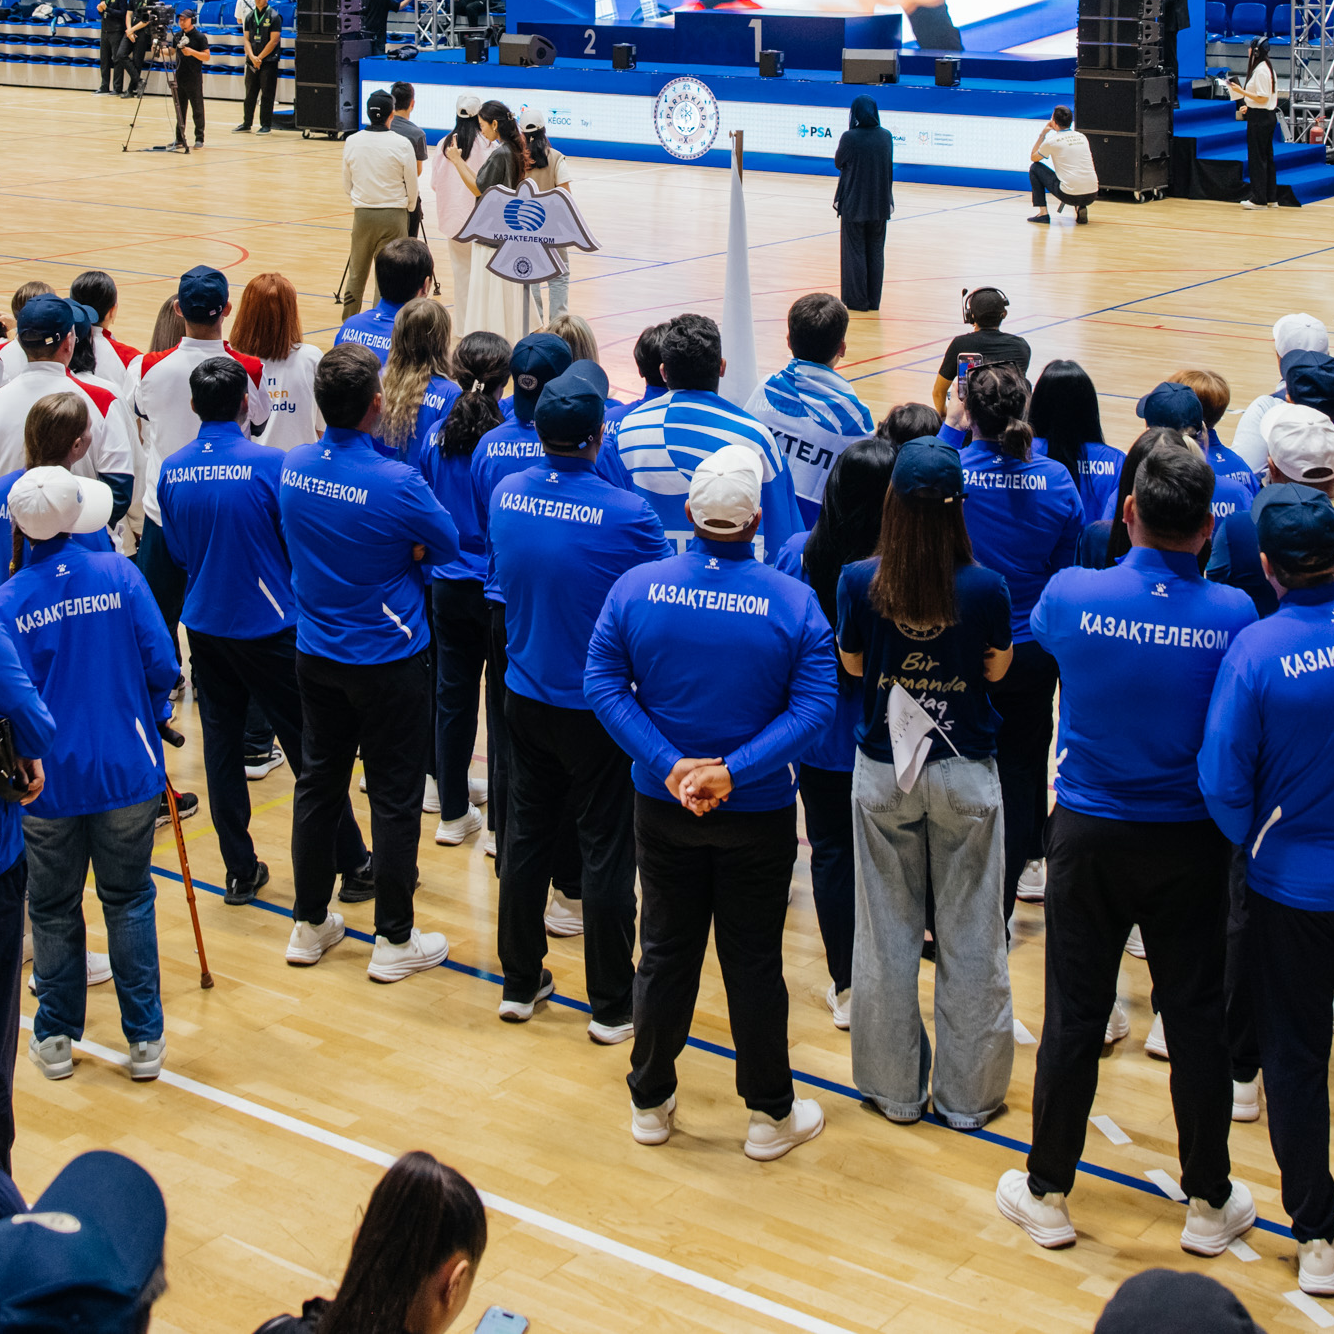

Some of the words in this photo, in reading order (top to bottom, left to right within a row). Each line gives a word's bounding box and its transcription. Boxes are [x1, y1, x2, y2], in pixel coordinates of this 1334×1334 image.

[584, 28, 597, 55] 2
[748, 18, 763, 63] 1
[547, 116, 572, 126] KEGOC
[666, 93, 707, 129] SPARTAKIADA
[810, 126, 833, 139] PSA
[493, 233, 556, 245] ҚАЗАҚТЕЛЕКОМ
[341, 327, 392, 351] ҚАЗАҚТЕЛЕКО
[487, 441, 546, 459] ҚАЗАҚТЕЛЕ
[167, 465, 252, 484] ҚАЗАҚТЕЛЕКОМ
[282, 468, 369, 505] ҚАЗАҚТЕЛЕКОМ
[962, 468, 1047, 491] ЗАҚТЕЛЕКОМ
[499, 491, 603, 526] ҚАЗАҚТЕЛЕКОМ
[648, 582, 770, 616] ҚАЗАҚТЕЛЕКОМ
[15, 592, 122, 634] ҚАЗАҚТЕЛЕКОМ
[1080, 611, 1230, 651] ҚАЗАҚТЕЛЕКОМ
[901, 651, 940, 672] Bir
